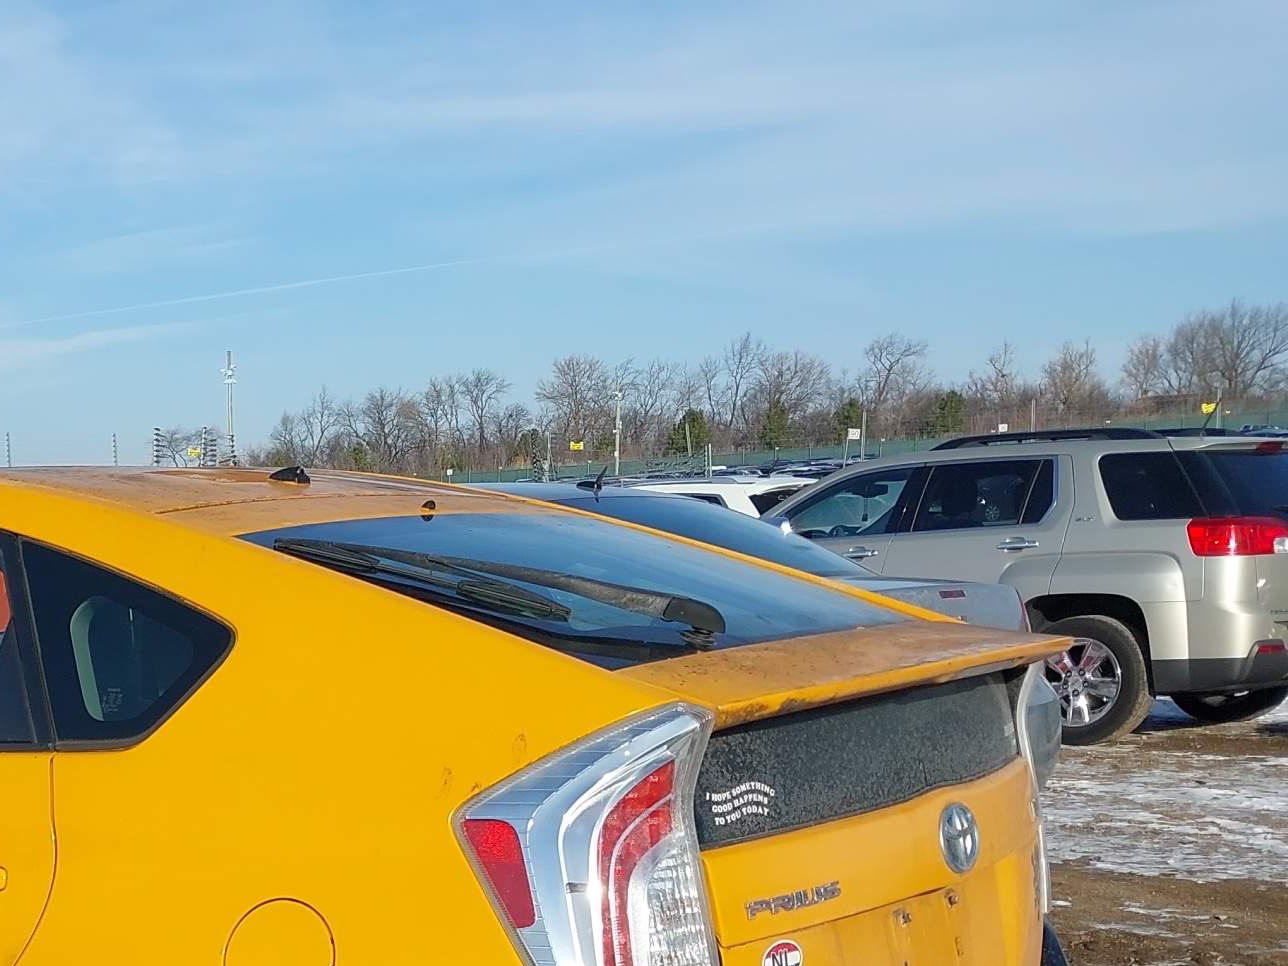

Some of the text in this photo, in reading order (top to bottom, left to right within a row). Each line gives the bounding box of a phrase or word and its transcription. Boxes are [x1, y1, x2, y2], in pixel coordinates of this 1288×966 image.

[706, 782, 775, 802] I HOPE SOMETHING
[712, 794, 768, 813] GOOD HAPPENS
[715, 805, 770, 826] TO YOU TODAY
[745, 881, 841, 920] PRIUS
